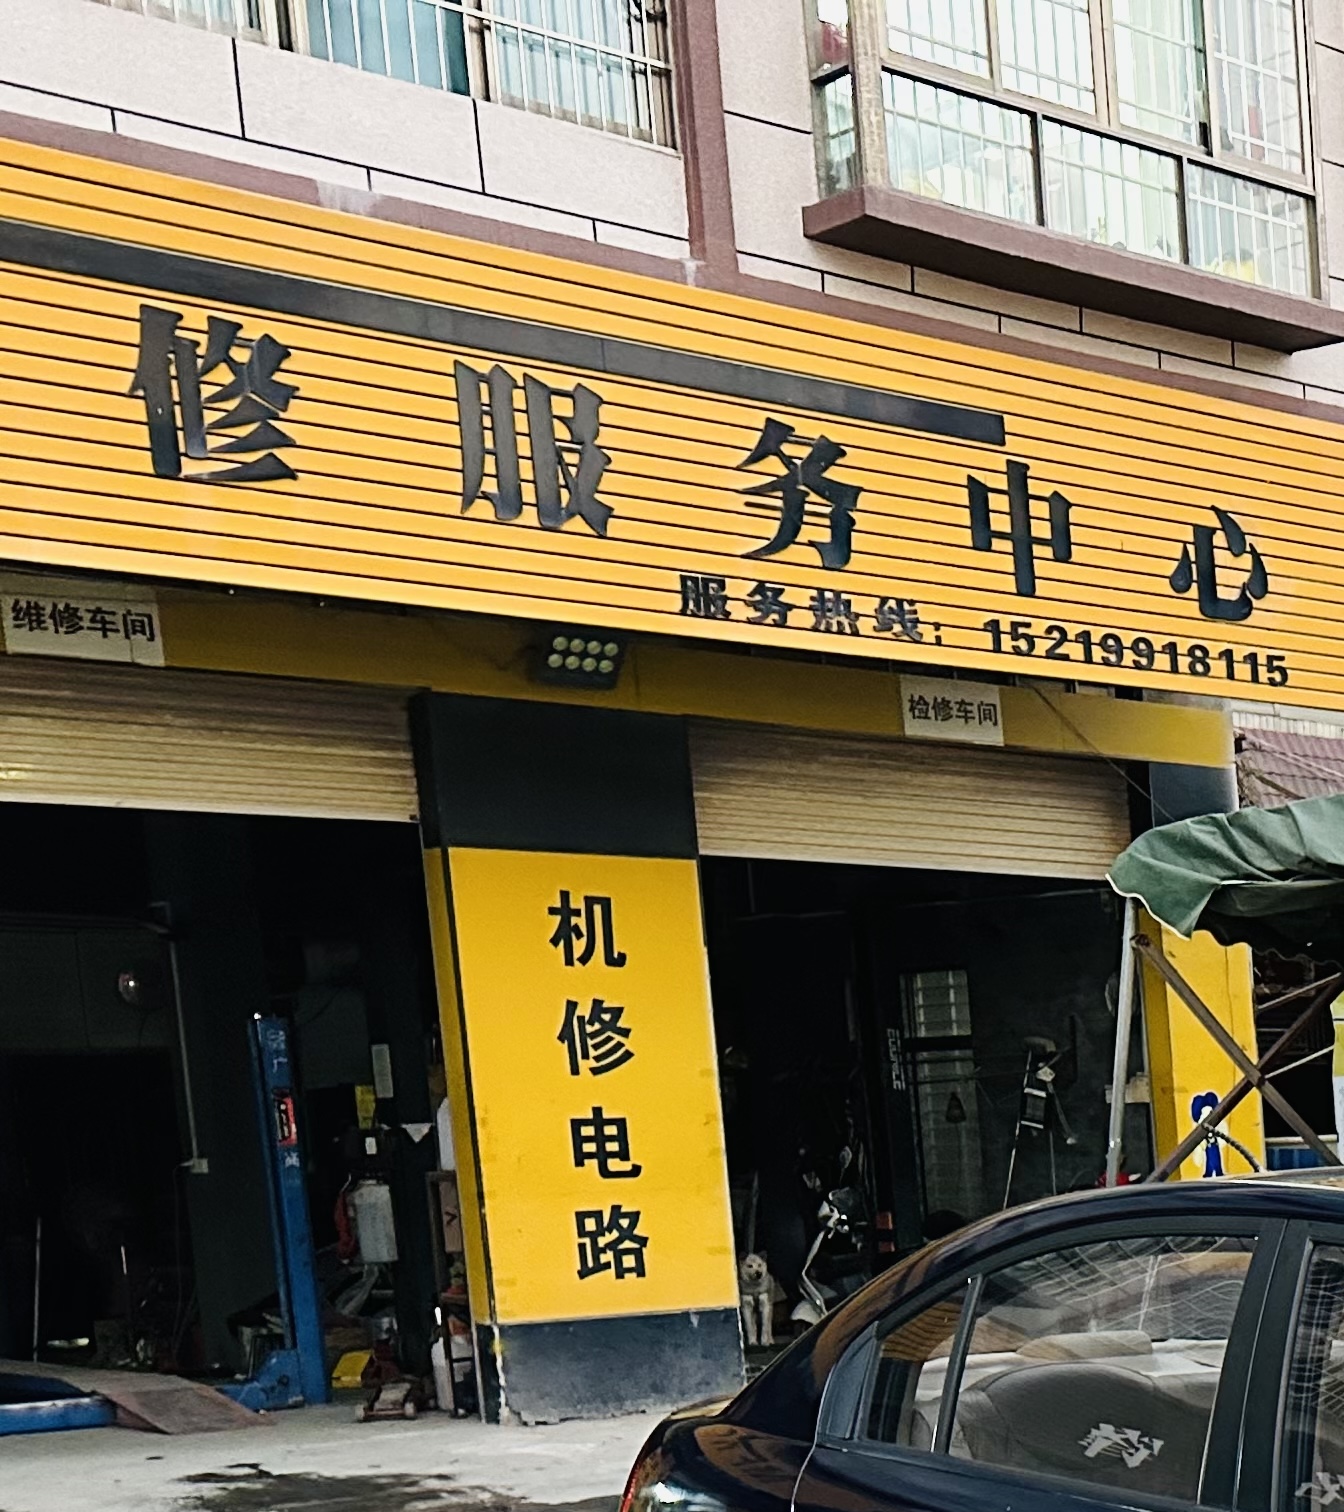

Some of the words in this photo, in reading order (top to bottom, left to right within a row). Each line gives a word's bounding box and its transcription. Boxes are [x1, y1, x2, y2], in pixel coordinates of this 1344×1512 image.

[12, 600, 156, 643] 维修车间
[984, 619, 1290, 688] 15219918115
[907, 694, 999, 728] 检修车间
[548, 888, 649, 1281] 机修电路
